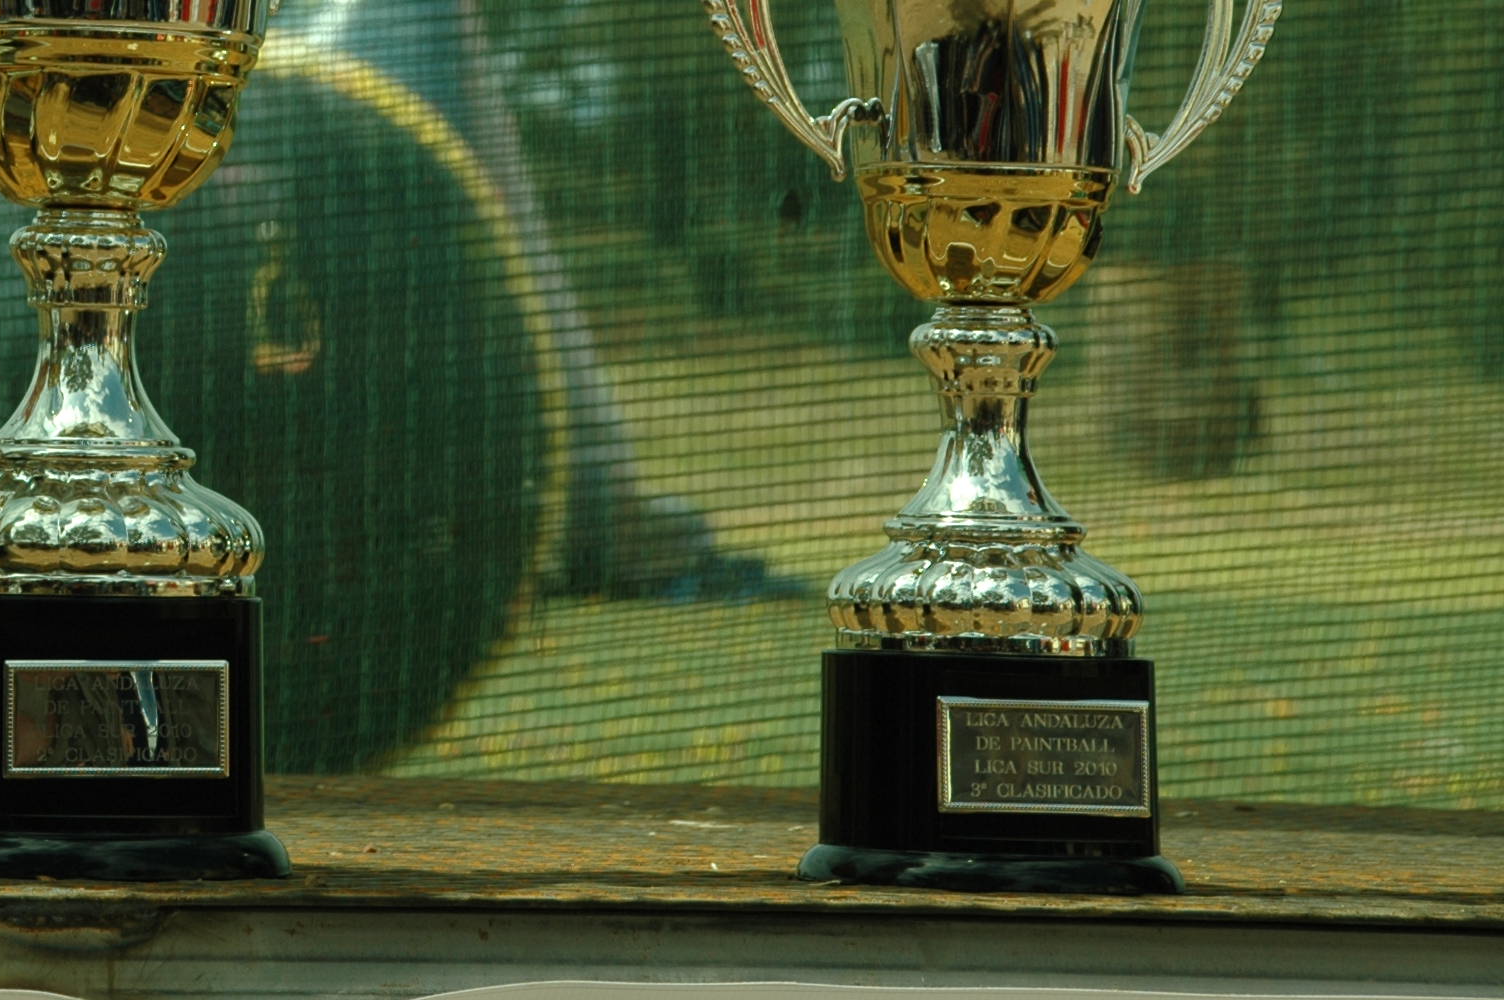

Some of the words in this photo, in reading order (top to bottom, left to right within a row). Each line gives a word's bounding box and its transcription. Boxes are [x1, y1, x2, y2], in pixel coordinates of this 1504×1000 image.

[90, 675, 201, 691] ANDUZA
[44, 699, 69, 714] DE
[1020, 712, 1124, 730] ANDALUZA
[147, 723, 192, 739] 010
[976, 736, 1001, 751] DE
[1011, 736, 1116, 753] PAINTBALL
[1027, 760, 1064, 776] SUR
[1074, 761, 1118, 777] 2010
[996, 782, 1123, 800] CLASIFICADO
